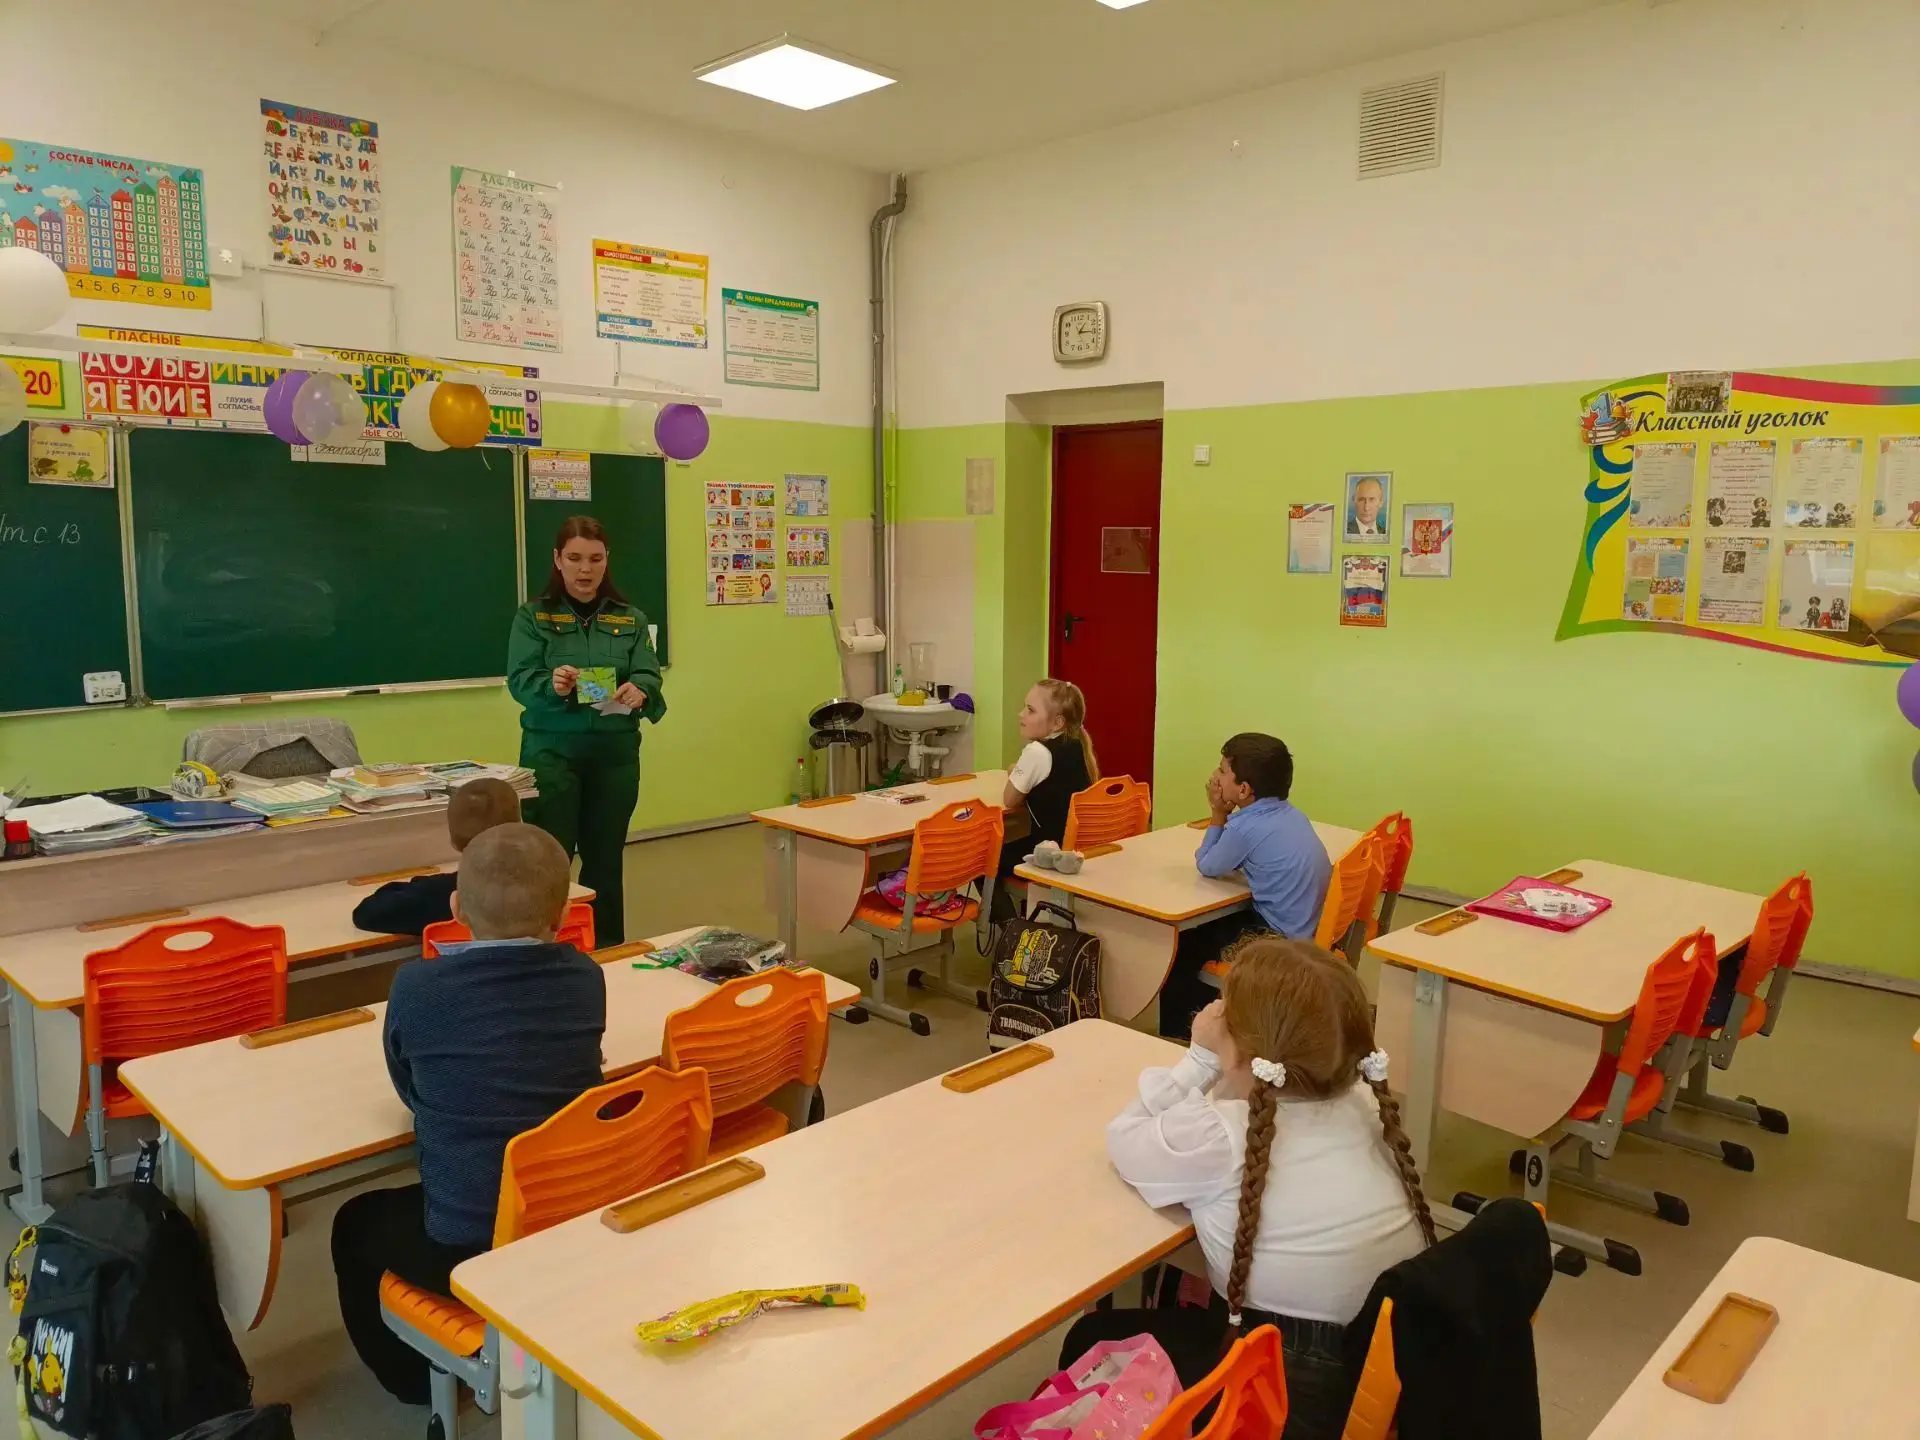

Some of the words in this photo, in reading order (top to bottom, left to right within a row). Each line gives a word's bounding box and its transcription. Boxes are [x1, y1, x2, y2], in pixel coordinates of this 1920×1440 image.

[290, 124, 297, 137] Б
[321, 131, 328, 144] В
[337, 134, 345, 146] Г
[49, 151, 93, 164] СОСТАВ
[97, 159, 134, 171] ЧИСЛА
[275, 142, 282, 158] Е
[296, 144, 304, 160] Ё
[318, 152, 333, 165] Ж
[346, 156, 353, 169] З
[359, 159, 369, 171] И
[270, 160, 280, 175] Й
[289, 166, 298, 179] К
[314, 169, 325, 180] Л
[341, 176, 353, 188] М
[269, 183, 278, 195] О
[292, 187, 302, 200] П
[317, 190, 326, 203] Р
[339, 195, 347, 207] С
[362, 199, 370, 212] Т
[294, 208, 304, 222] Ф
[319, 211, 329, 224] Х
[346, 215, 358, 231] Ц
[295, 229, 312, 245] Щ
[323, 233, 331, 246] Ъ
[344, 237, 356, 250] Ы
[369, 240, 376, 252] Ь
[301, 251, 310, 264] Э
[323, 254, 336, 268] Ю
[344, 259, 352, 271] Я
[76, 279, 83, 289] 4
[95, 281, 102, 291] 5
[112, 283, 119, 293] 6
[129, 285, 136, 295] 7
[148, 287, 154, 296] 8
[164, 288, 171, 298] 9
[182, 291, 194, 301] 10
[109, 330, 181, 345] ГЛАСНЫЕ
[332, 351, 410, 365] СОГЛАСНЫЕ
[24, 370, 51, 395] 20
[218, 403, 261, 411] СОГЛАСНЫЕ
[373, 401, 389, 424] К
[1591, 392, 1614, 427] 1
[527, 413, 538, 432] Ъ
[1636, 410, 1743, 432] Классный
[1747, 410, 1829, 434] уголок
[58, 522, 80, 544] 13
[1001, 1017, 1045, 1036] TRANSFORMERS
